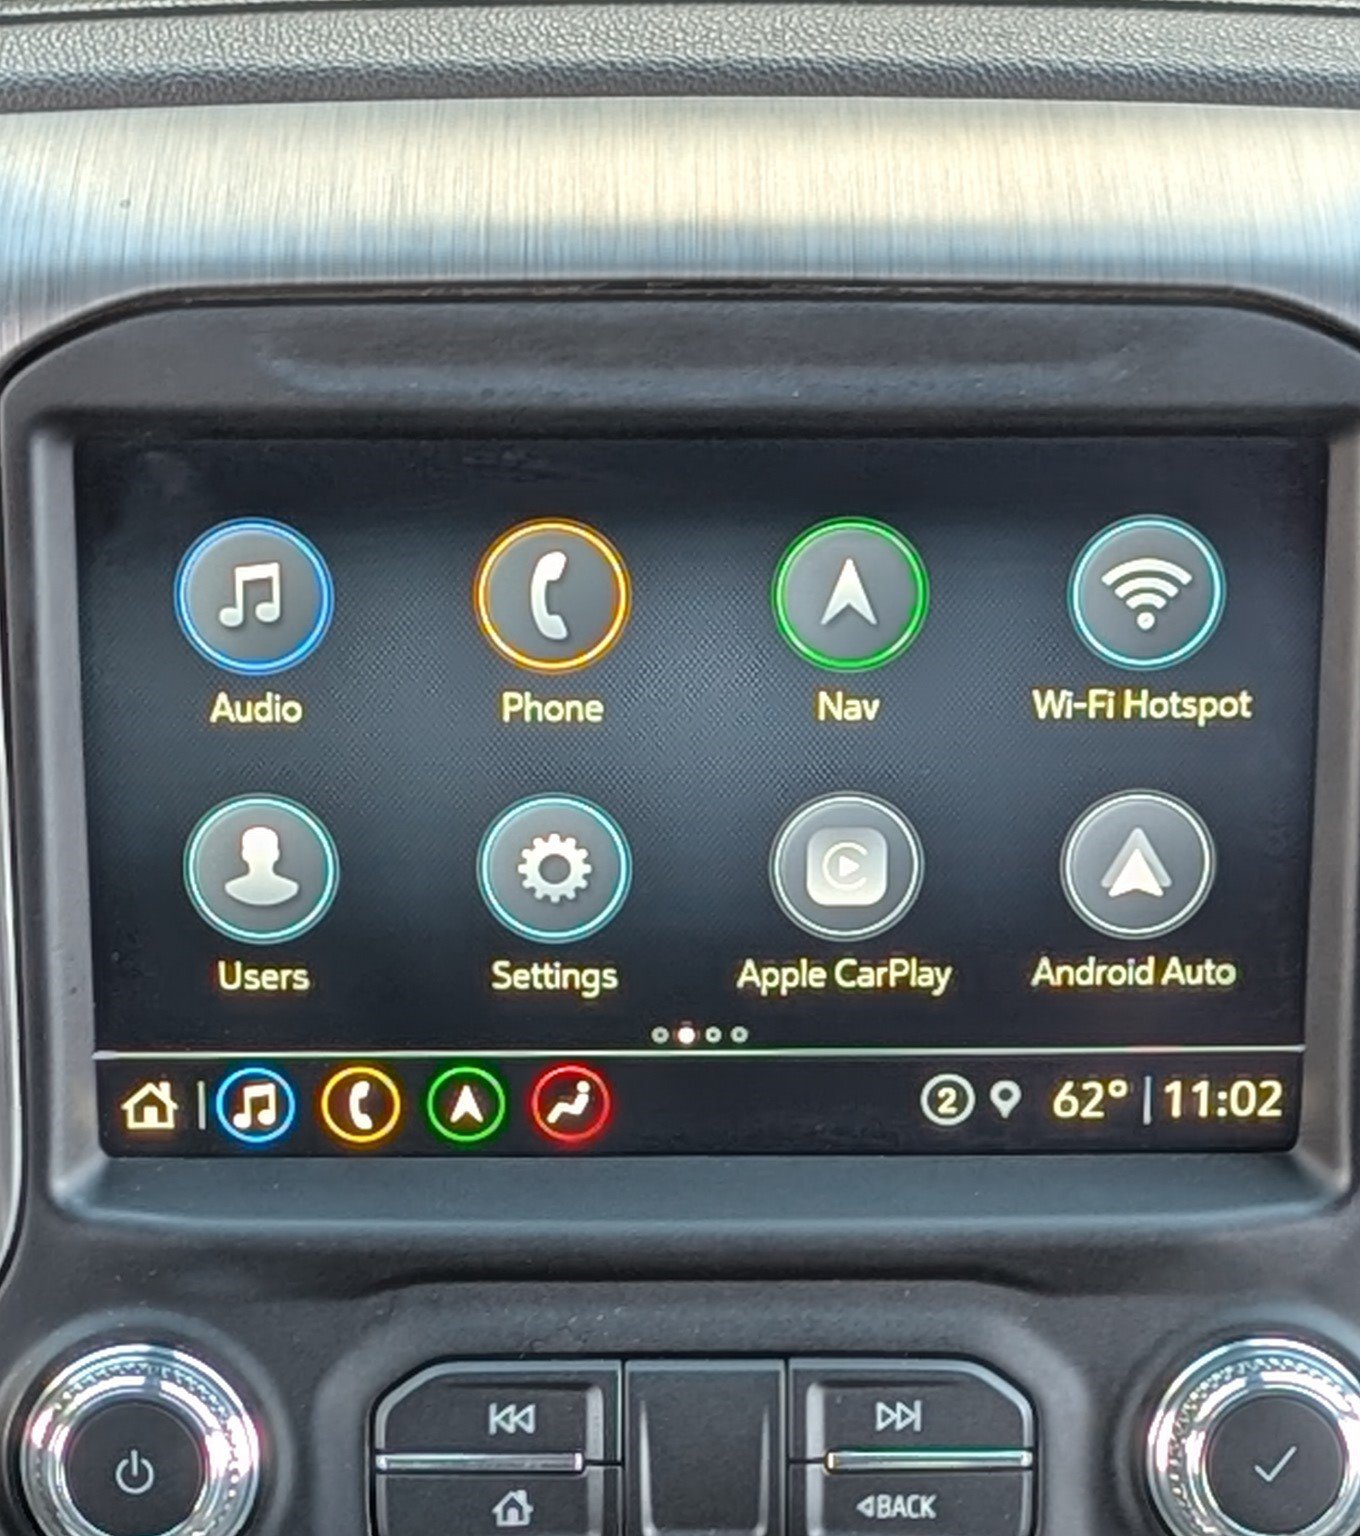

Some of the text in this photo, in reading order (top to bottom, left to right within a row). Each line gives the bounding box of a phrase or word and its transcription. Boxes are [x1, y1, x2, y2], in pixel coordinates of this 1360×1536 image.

[209, 691, 303, 724] Audio
[502, 691, 604, 724] Phone
[818, 690, 881, 721] Nav
[1032, 688, 1253, 727] Wi-Fi Hotspot
[218, 960, 310, 991] Users
[492, 960, 619, 999] Settings
[736, 957, 953, 996] Apple CarPlay
[1031, 955, 1237, 987] Android Auto
[937, 1087, 958, 1116] 2
[1053, 1080, 1128, 1119] 62°
[1164, 1080, 1283, 1118] 11:02
[876, 1494, 936, 1519] BACK
